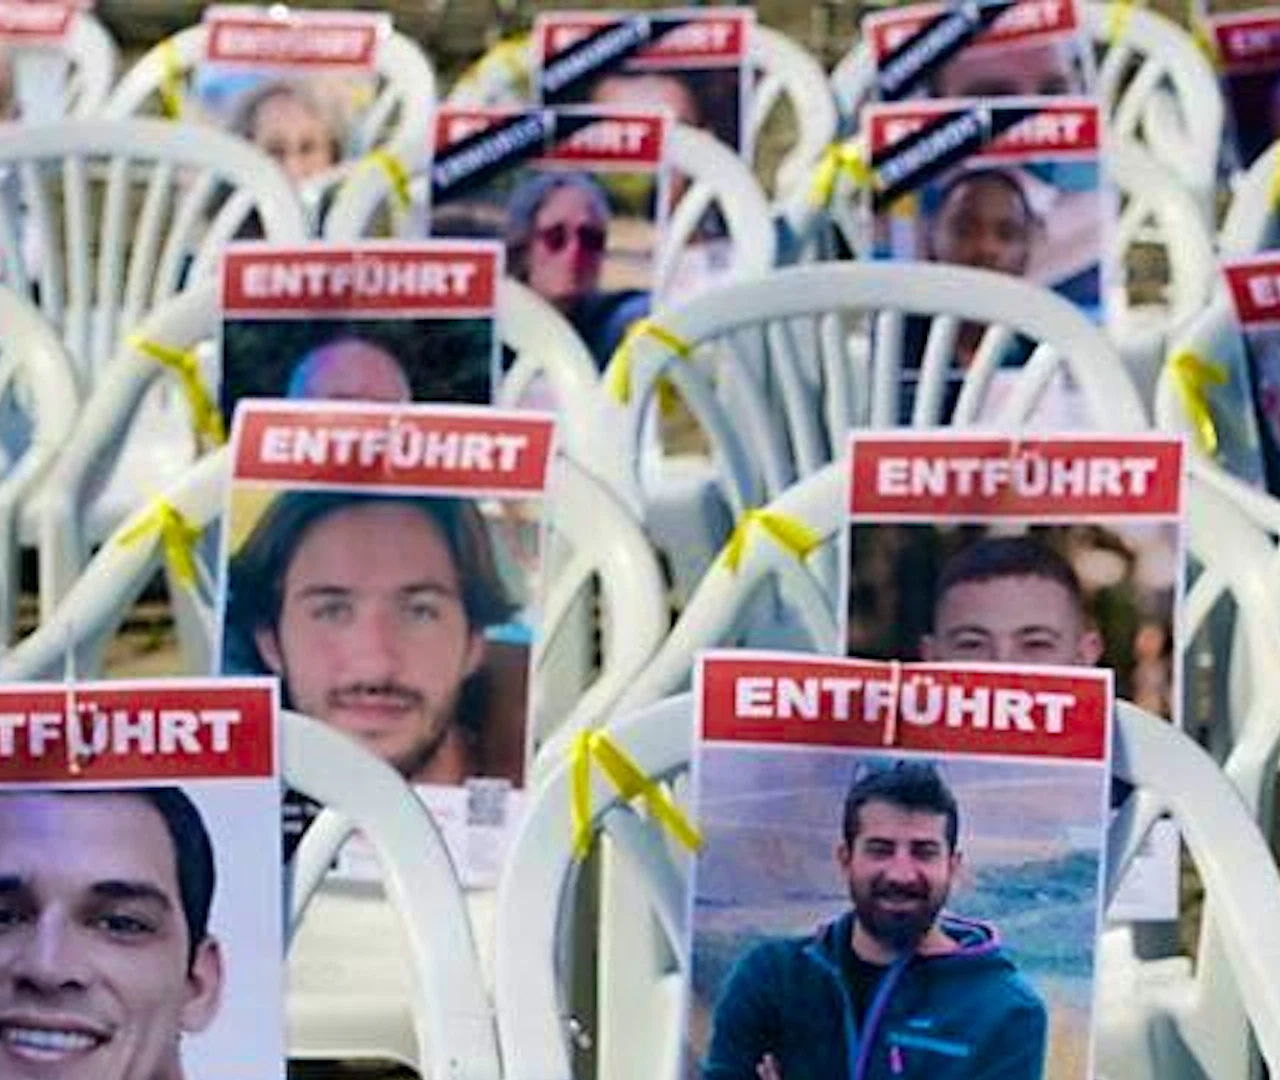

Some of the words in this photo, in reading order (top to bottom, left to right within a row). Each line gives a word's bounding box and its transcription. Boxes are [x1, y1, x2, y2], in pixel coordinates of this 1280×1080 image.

[259, 423, 527, 472] ENTFÜHRT
[877, 446, 1158, 497] ENTFÜHRT
[734, 676, 1075, 734] ENTFÜHRT
